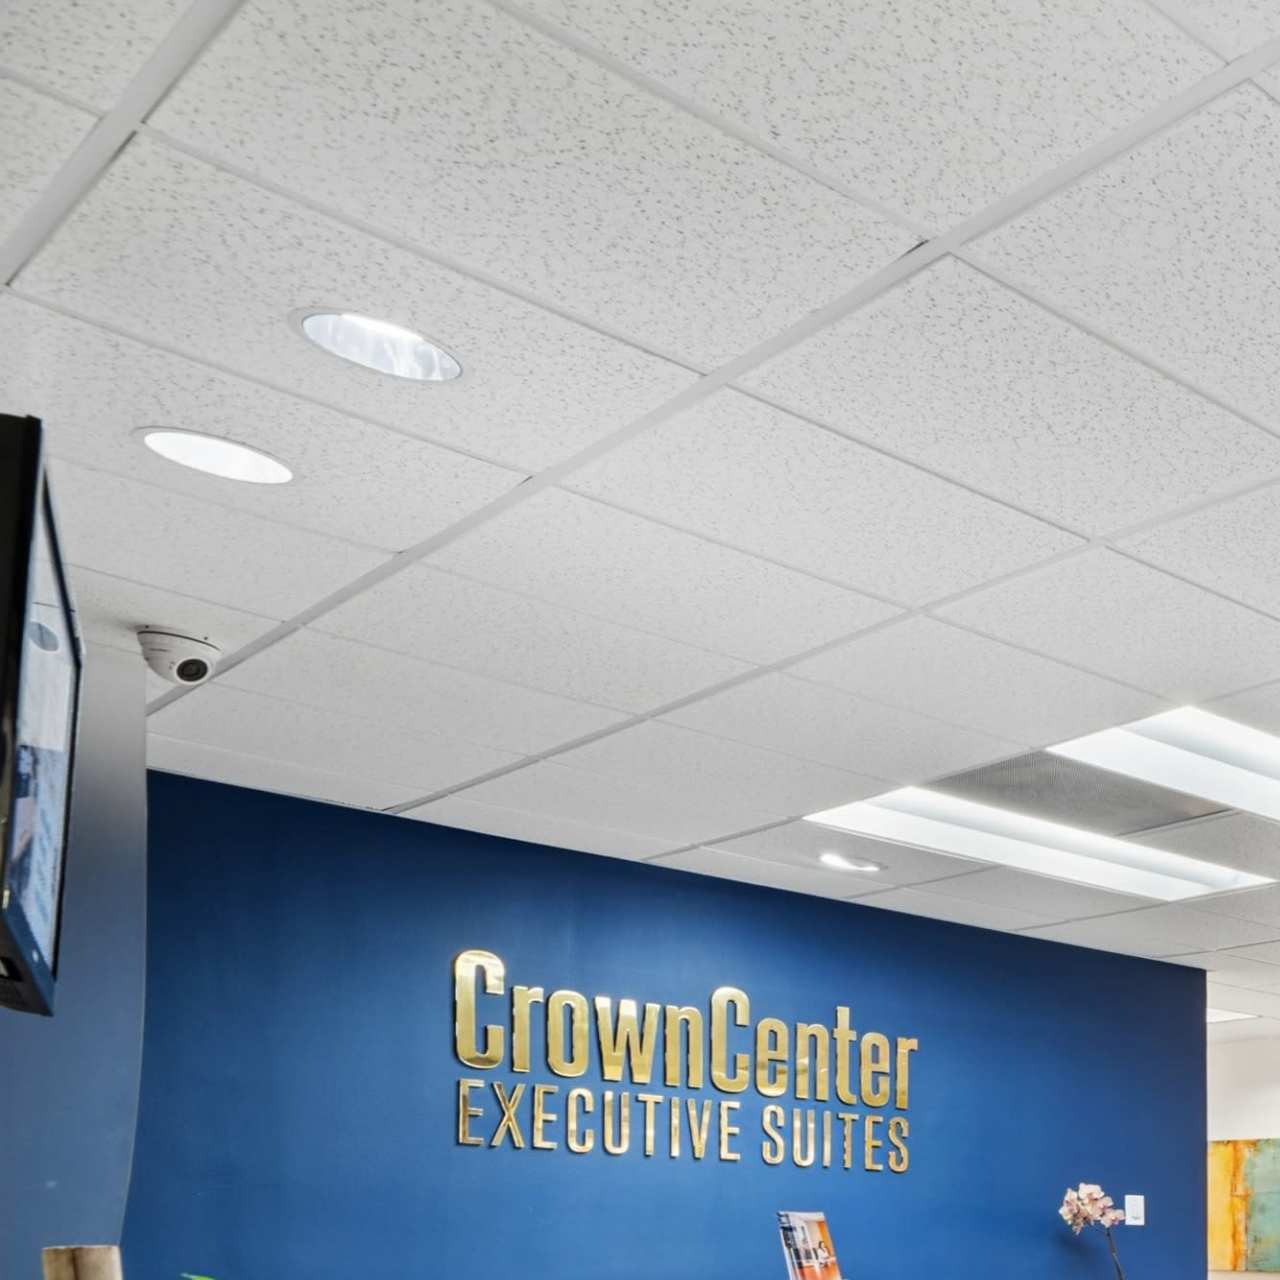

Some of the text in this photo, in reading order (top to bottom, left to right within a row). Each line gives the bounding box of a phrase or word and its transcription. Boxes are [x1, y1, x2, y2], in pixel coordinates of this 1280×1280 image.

[454, 950, 918, 1110] CrownCenter
[457, 1079, 910, 1172] EXECUTIVE SUITES
